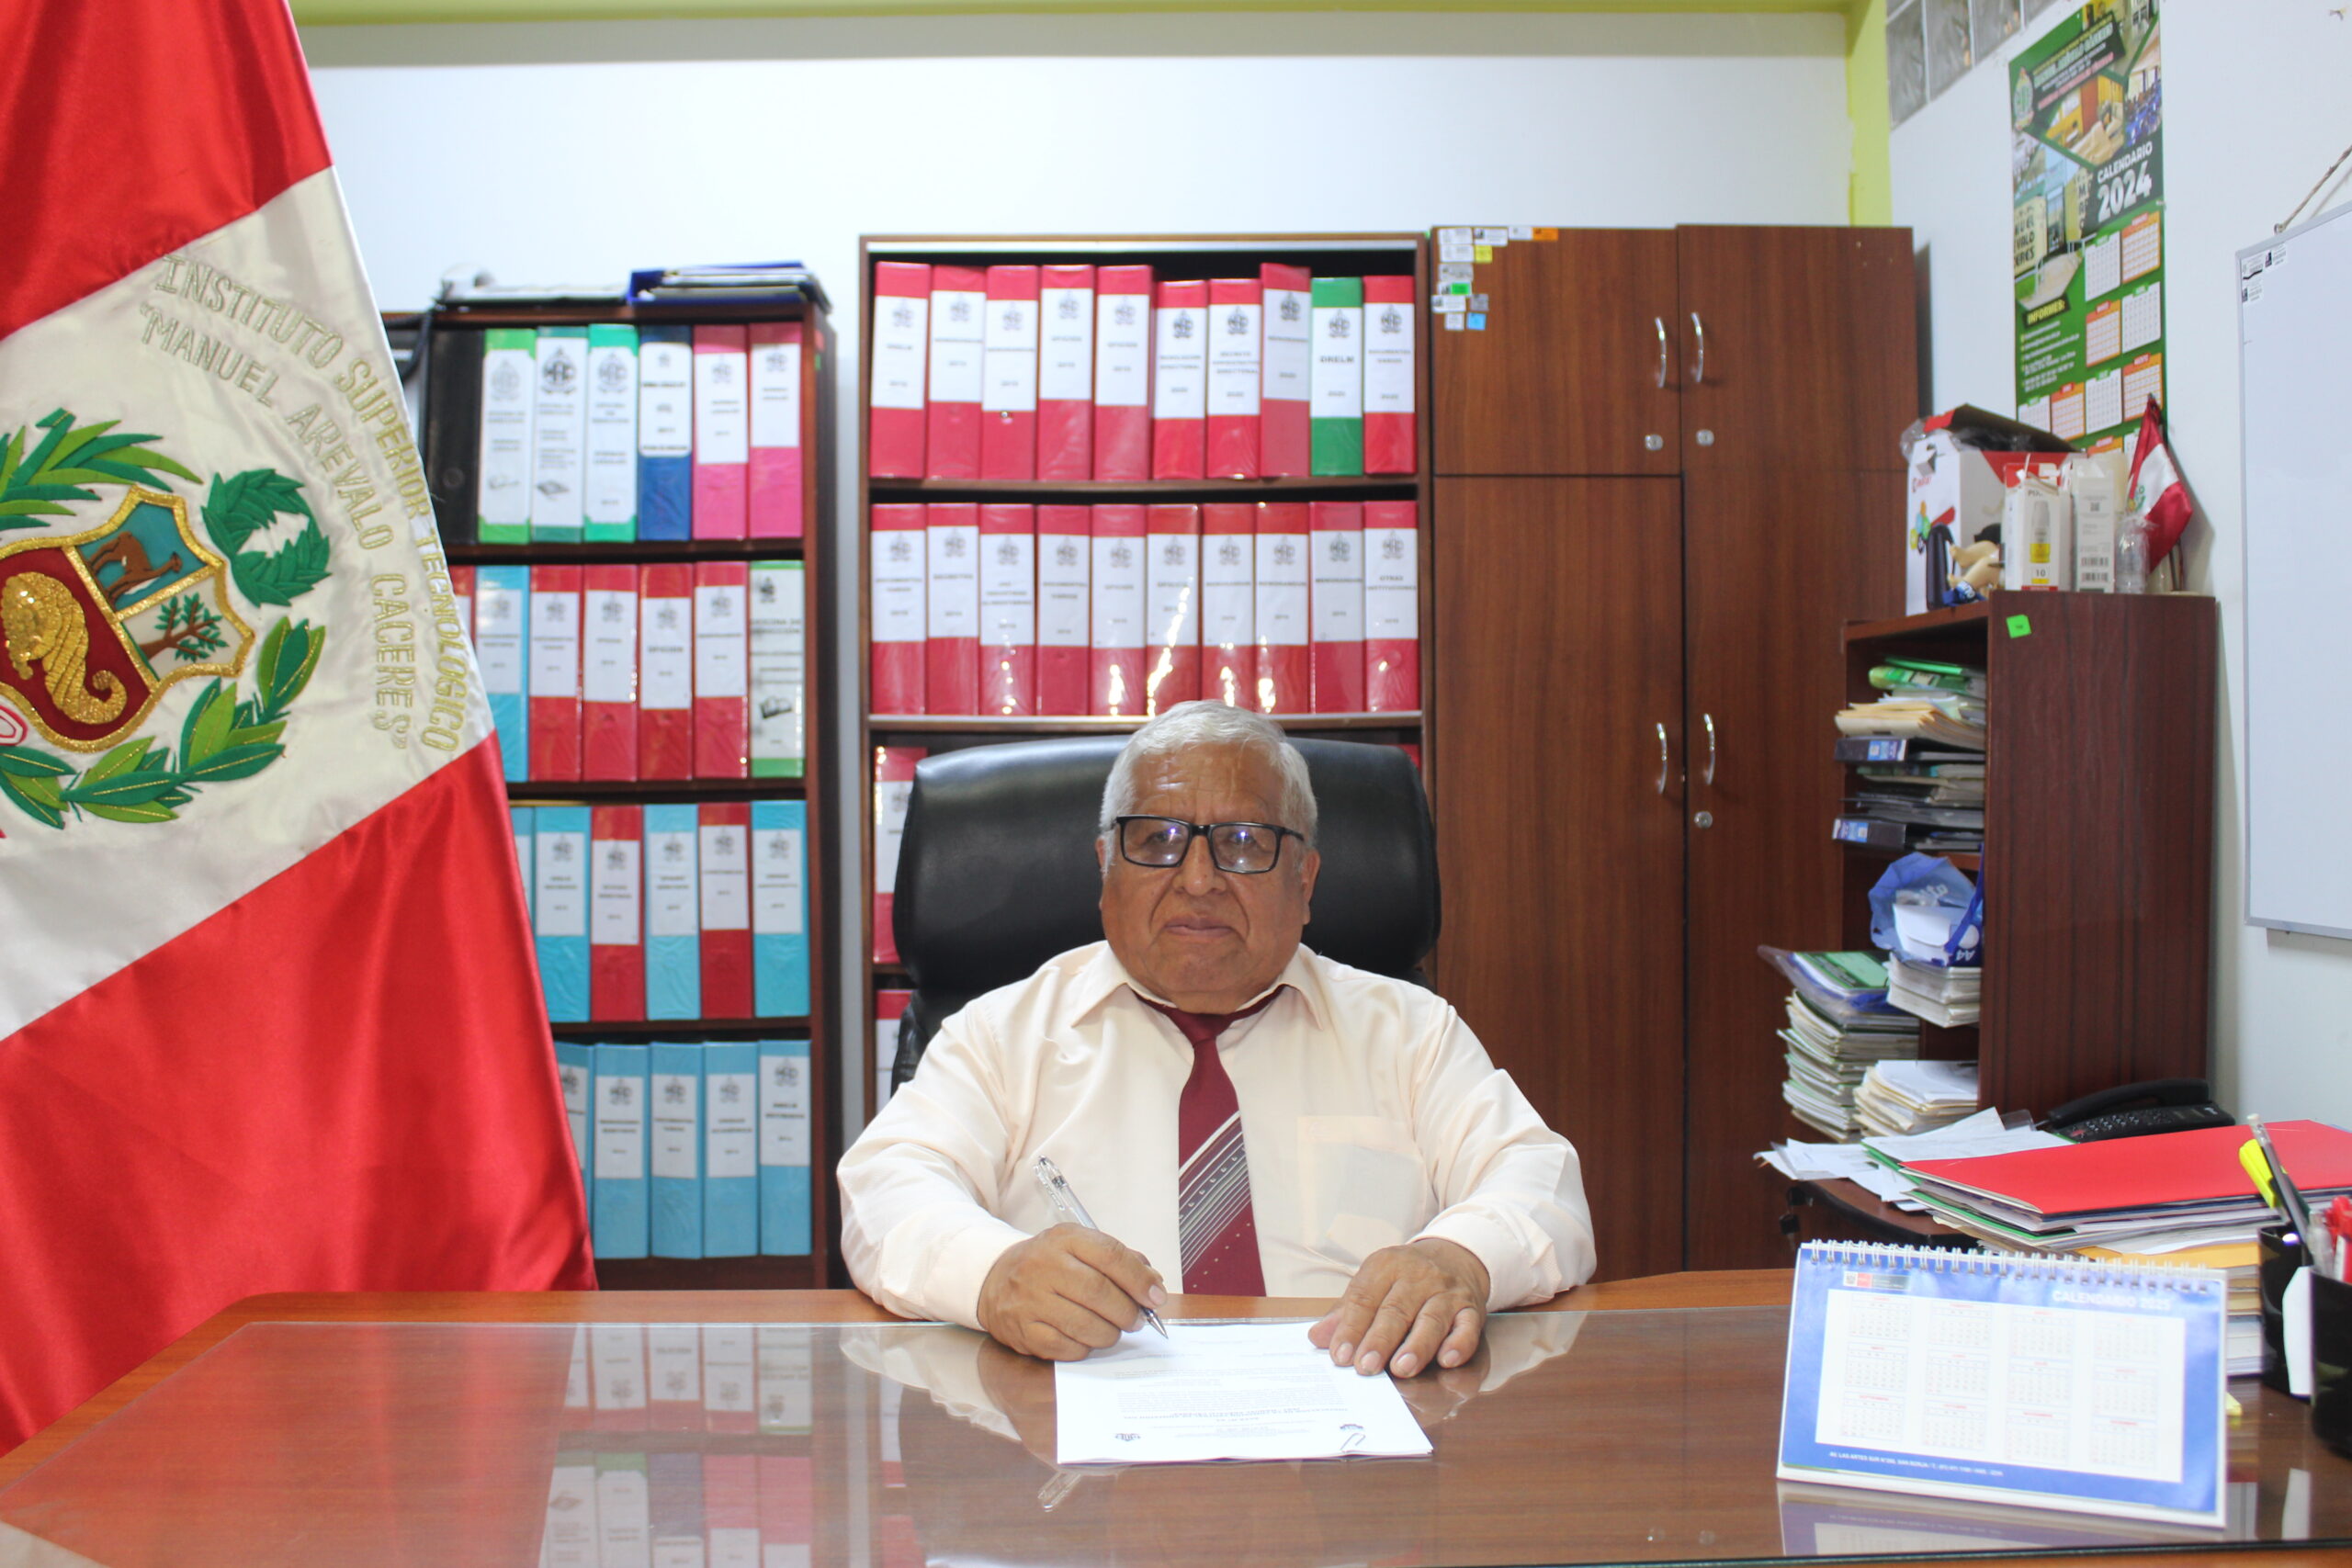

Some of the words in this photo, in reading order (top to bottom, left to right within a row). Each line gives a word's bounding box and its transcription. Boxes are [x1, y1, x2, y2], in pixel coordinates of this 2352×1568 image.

[2098, 141, 2154, 185] CALENDARIO
[2098, 161, 2153, 223] 2024
[2027, 299, 2065, 324] INFORMES:
[286, 403, 395, 551] AREVALO
[154, 254, 345, 369] INSTITUTO
[333, 357, 432, 519] SUPERIOR
[415, 528, 469, 751] TECNOLOGICO
[2034, 569, 2047, 578] 10
[1955, 949, 1975, 962] A4
[2052, 1290, 2137, 1307] CALENDARIO
